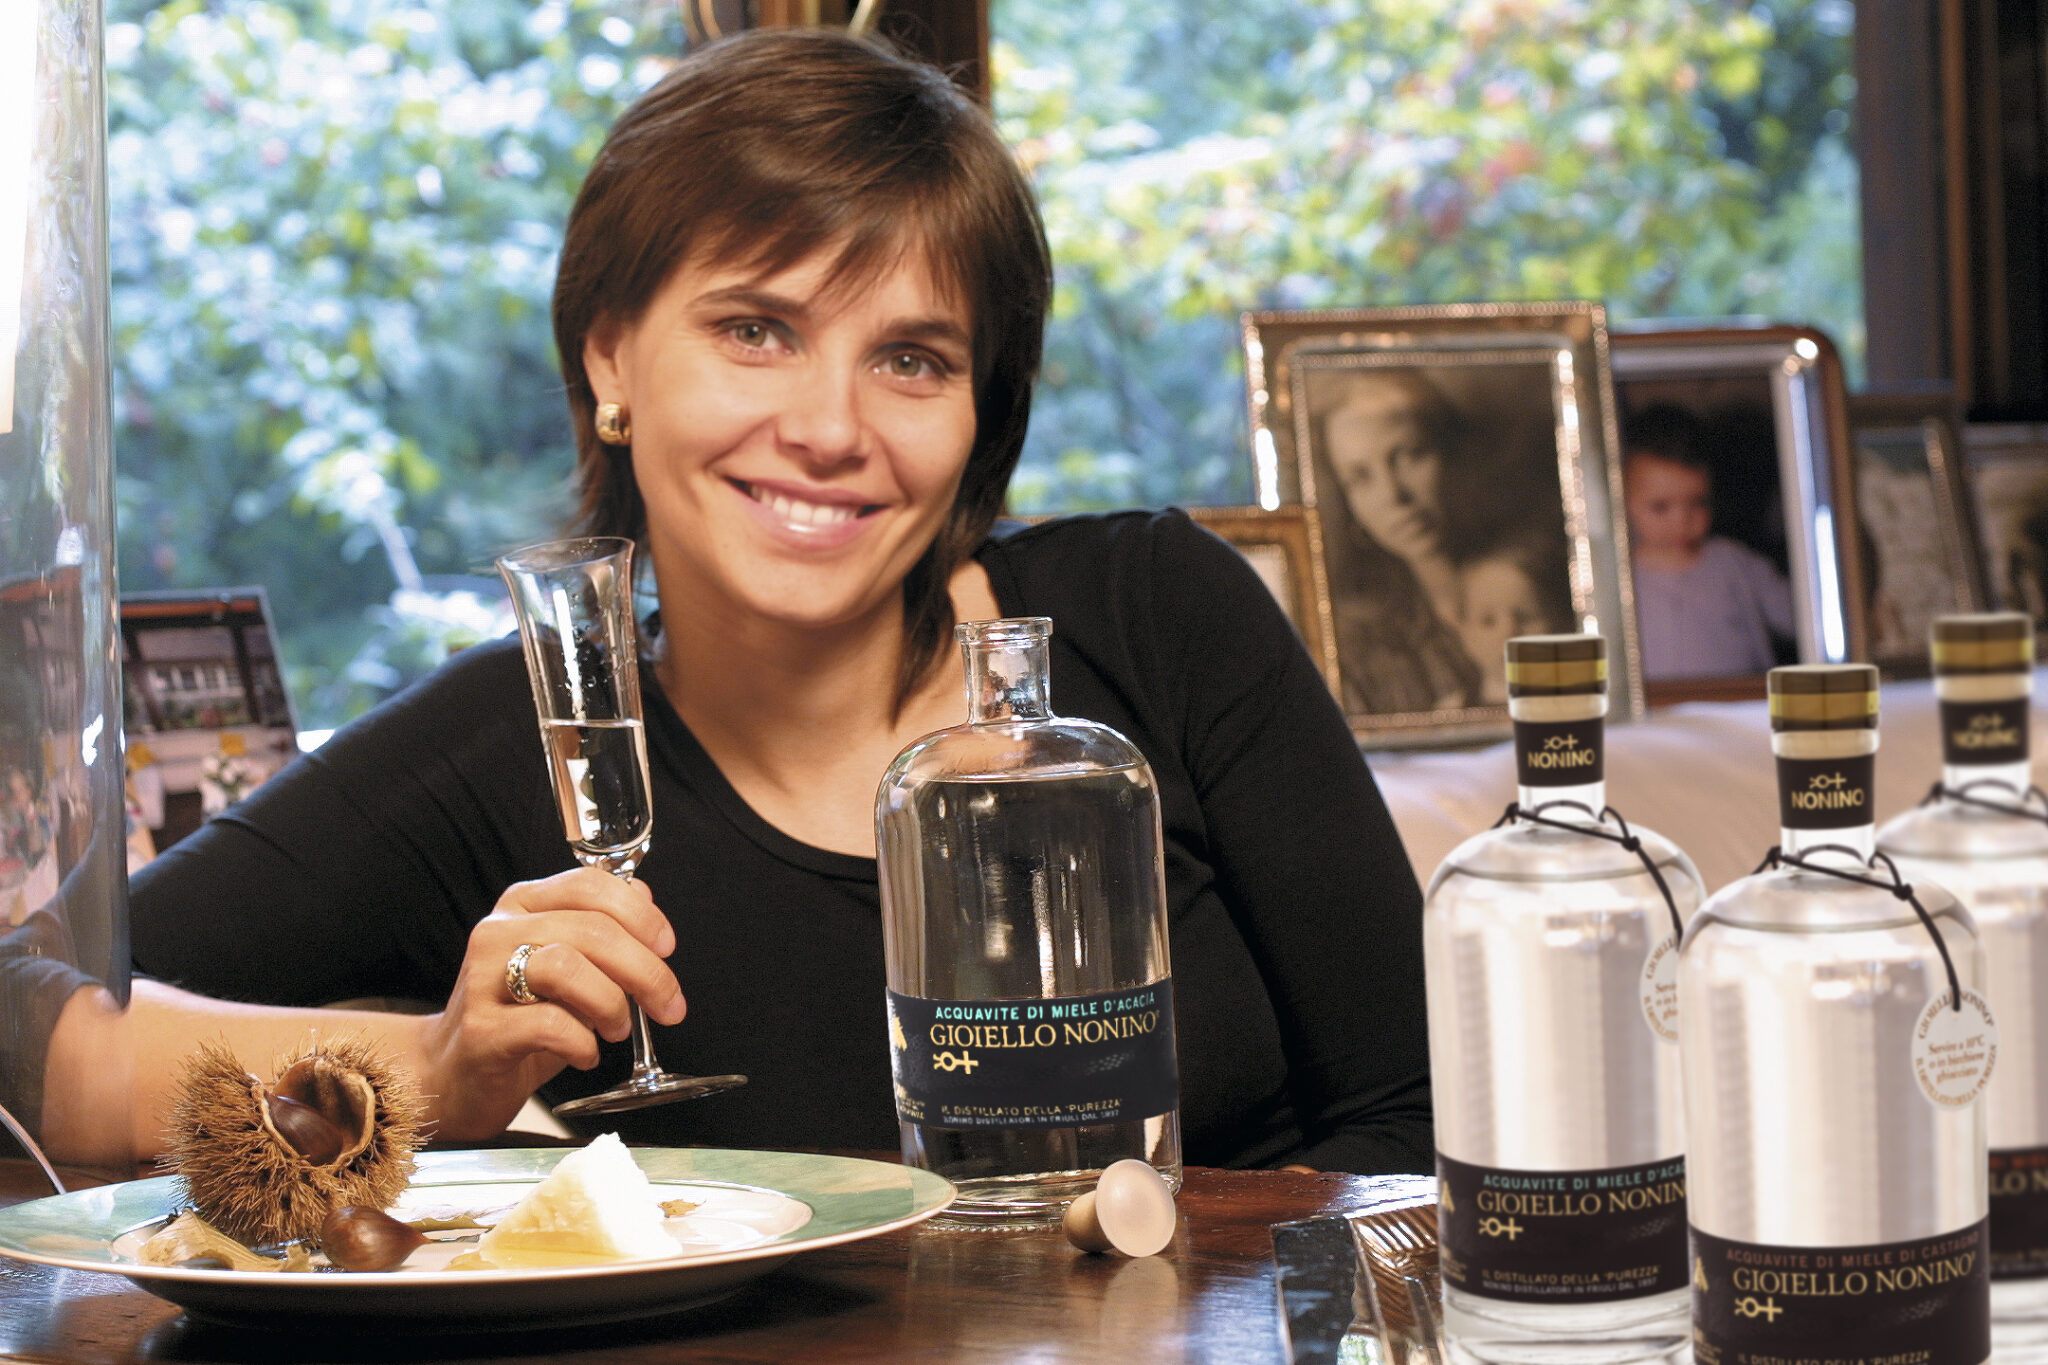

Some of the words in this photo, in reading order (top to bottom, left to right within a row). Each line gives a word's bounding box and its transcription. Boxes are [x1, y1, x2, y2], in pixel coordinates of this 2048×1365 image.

[1528, 748, 1595, 770] NONINO
[1792, 787, 1864, 811] NONINO
[935, 1006, 1020, 1021] ACQUAVITE
[1027, 1005, 1044, 1020] DI
[1051, 1001, 1098, 1019] MIELE
[1103, 991, 1156, 1013] D'ACACIA
[929, 1023, 1057, 1049] GIOIELLO
[954, 1105, 1019, 1118] DISTILLATO
[1024, 1105, 1061, 1117] DELLA
[1483, 1174, 1566, 1191] ACQUAVITE
[1573, 1177, 1590, 1191] DI
[1597, 1172, 1642, 1189] MIELE
[1477, 1190, 1602, 1217] GIOIELLO
[1727, 1248, 1809, 1269] ACQUAVITE
[1816, 1256, 1834, 1269] DI
[1841, 1251, 1893, 1268] MIELE
[1900, 1250, 1916, 1264] DI
[1921, 1231, 1980, 1259] CASTAGNO
[1494, 1271, 1558, 1285] DISTILLATO
[1562, 1273, 1599, 1285] DELLA
[1732, 1267, 1868, 1296] GIOIELLO
